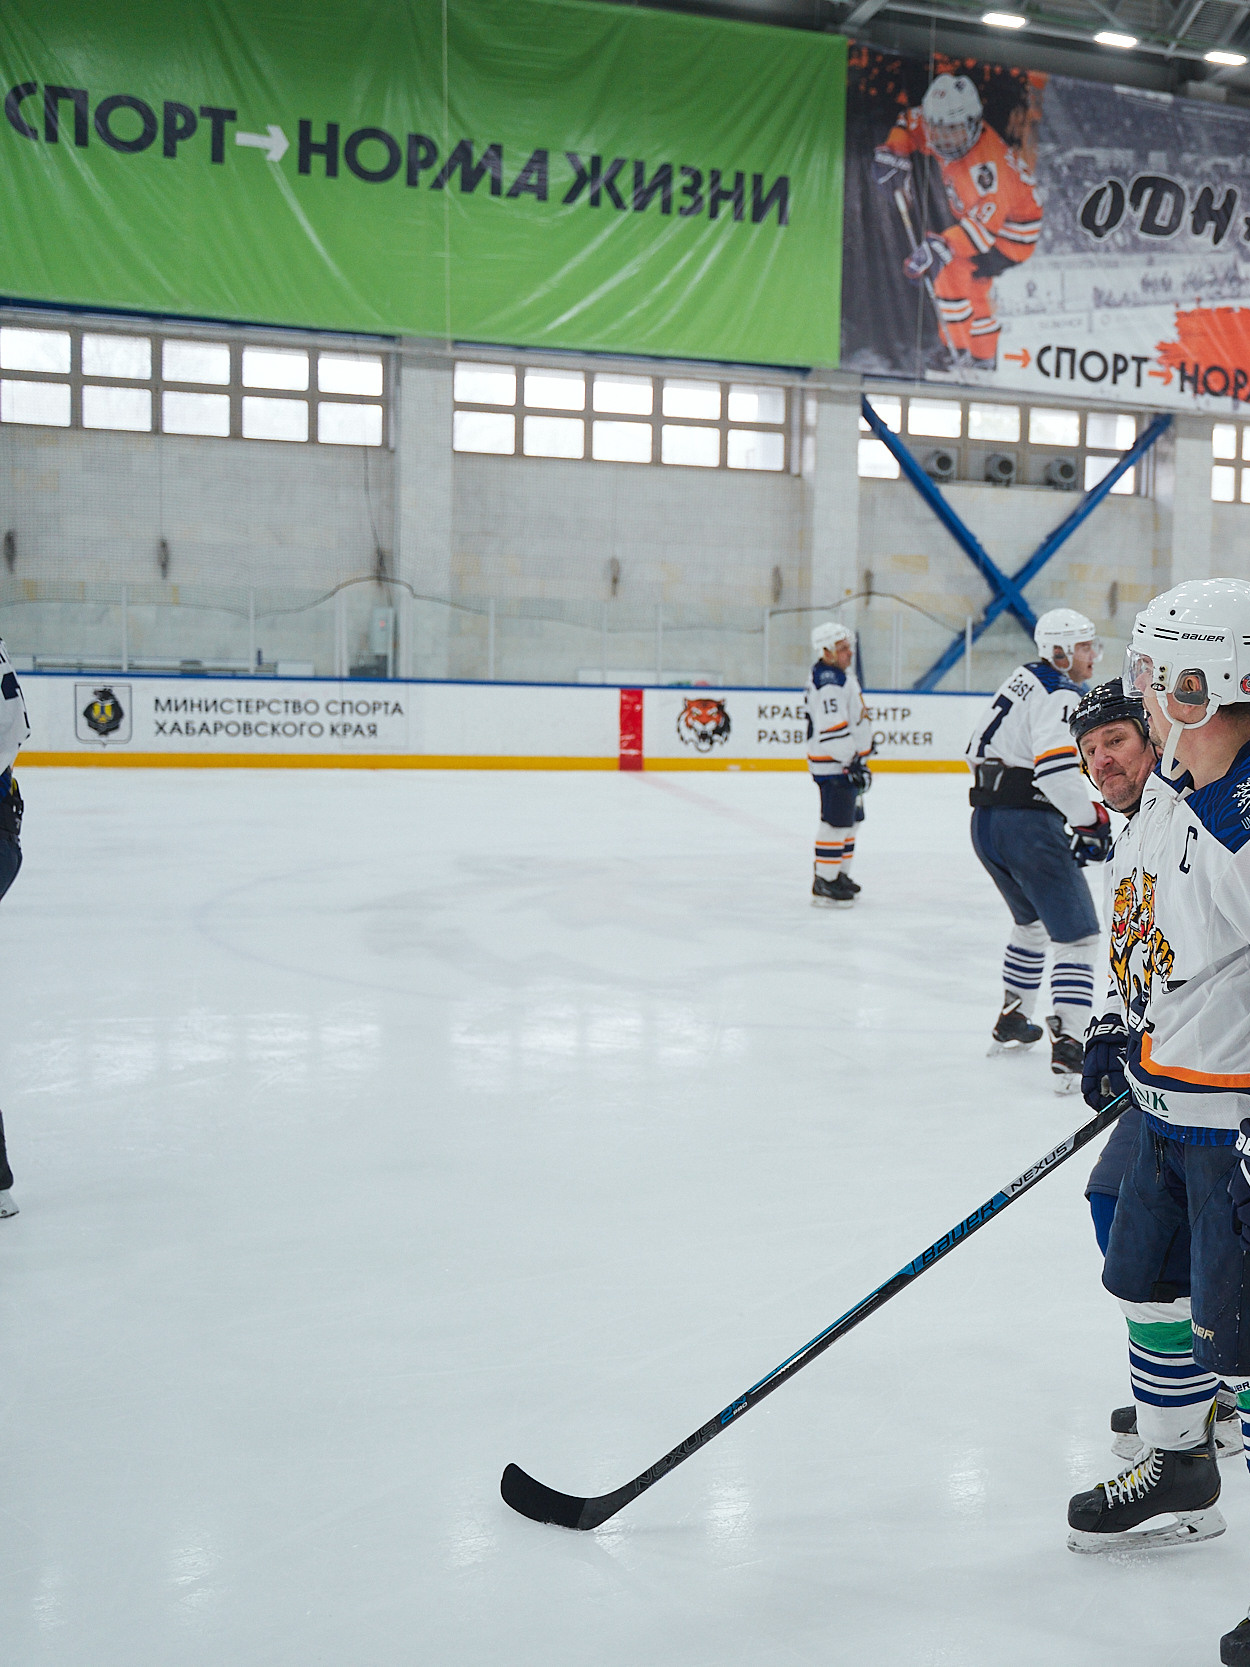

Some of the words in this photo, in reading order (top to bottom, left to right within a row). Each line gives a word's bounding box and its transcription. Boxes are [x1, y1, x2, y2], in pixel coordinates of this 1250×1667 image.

[5, 82, 237, 165] СПОРТ
[297, 119, 549, 203] НОРМА
[563, 154, 791, 227] ЖИЗНИ
[1037, 345, 1149, 387] СПОРТ
[1181, 632, 1225, 643] BAUER
[154, 696, 321, 716] МИНИСТЕРСТВО
[325, 699, 404, 717] СПОРТА
[757, 705, 806, 720] КРАЕ
[865, 707, 911, 720] ЕНТР
[823, 698, 838, 714] 15
[1061, 705, 1069, 723] 1
[154, 719, 325, 738] ХАБАРОВСКОГО
[330, 722, 378, 738] КРАЯ
[966, 694, 1014, 758] 7
[757, 730, 803, 744] РАЗВ
[872, 731, 933, 746] ОККЕЯ
[1179, 825, 1198, 874] C
[1083, 1023, 1129, 1041] UER
[922, 1198, 996, 1266] BAUER
[1010, 1143, 1067, 1192] NEXUS
[1192, 1323, 1215, 1341] UER
[733, 1402, 748, 1415] PRO
[635, 1420, 718, 1492] NEXUS
